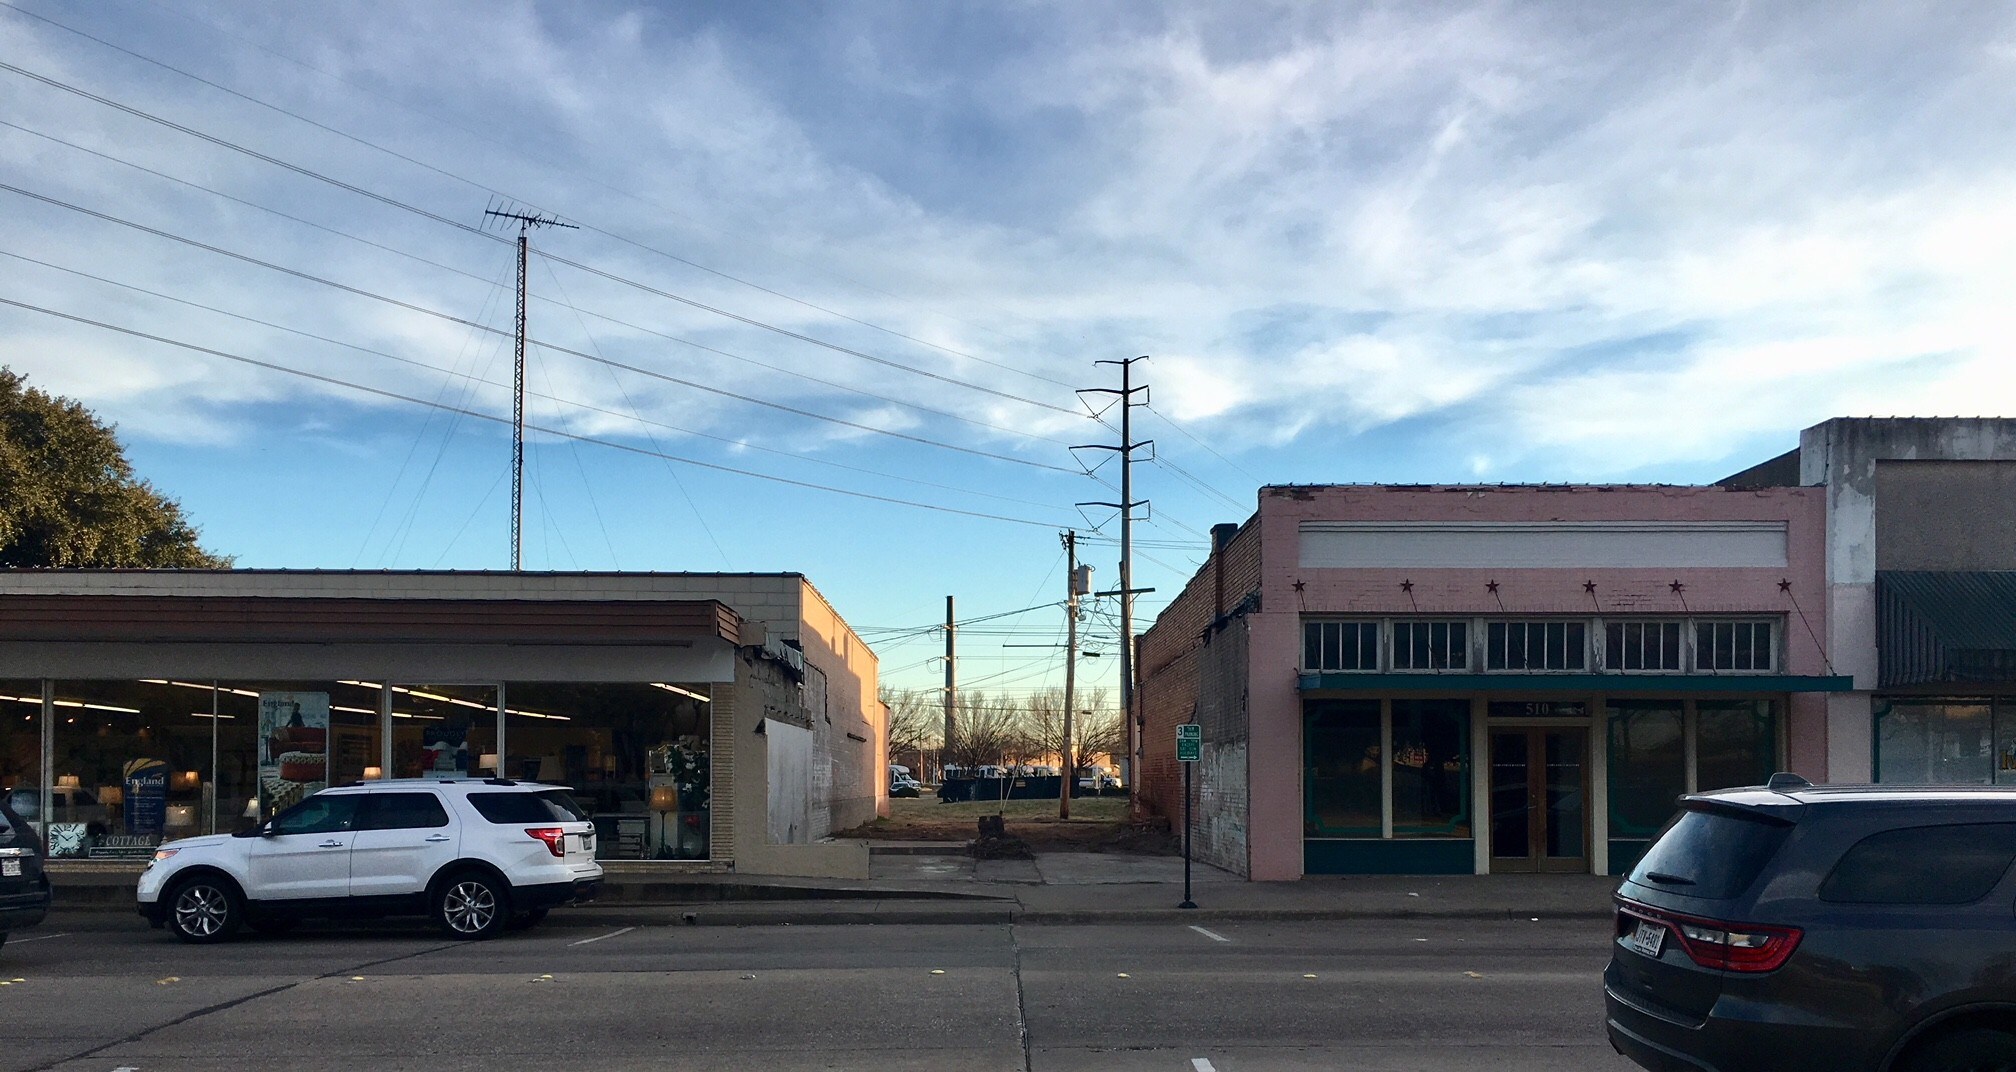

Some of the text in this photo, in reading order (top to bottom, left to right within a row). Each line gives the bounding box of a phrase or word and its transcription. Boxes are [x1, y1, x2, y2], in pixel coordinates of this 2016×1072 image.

[1526, 703, 1549, 715] 510
[1178, 727, 1183, 736] 3
[125, 776, 164, 787] England
[105, 835, 151, 846] COTTAGE
